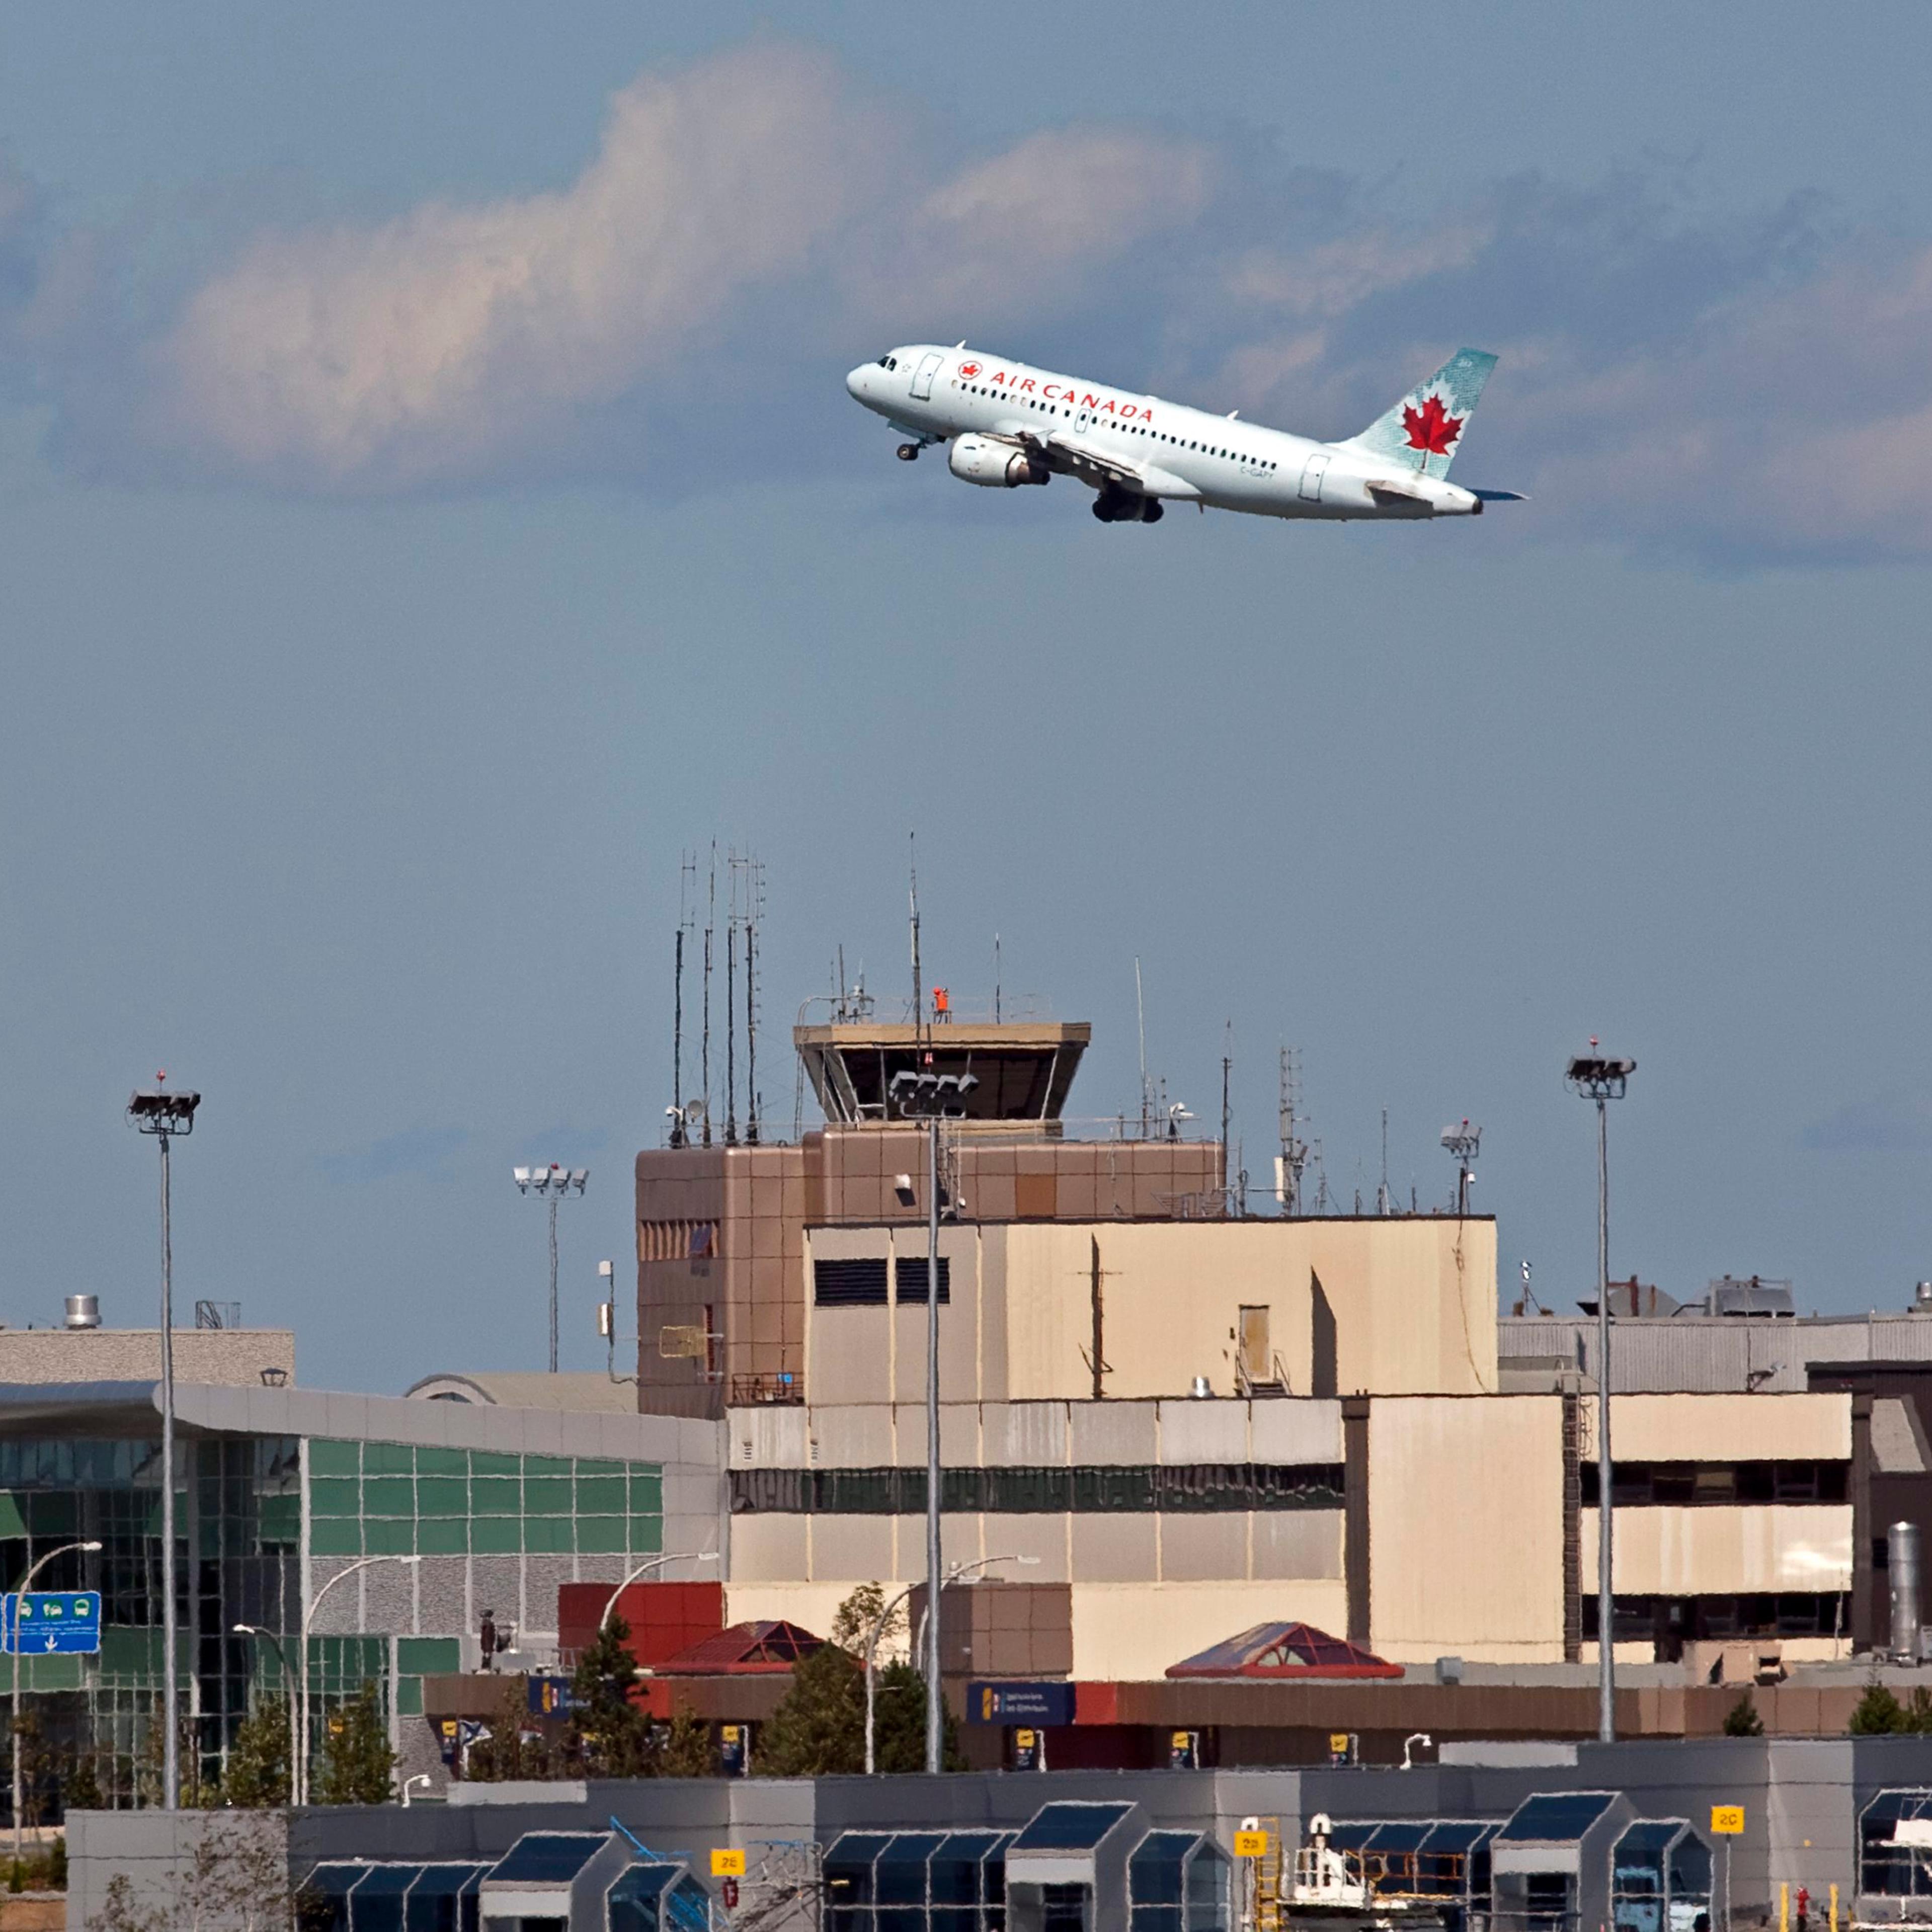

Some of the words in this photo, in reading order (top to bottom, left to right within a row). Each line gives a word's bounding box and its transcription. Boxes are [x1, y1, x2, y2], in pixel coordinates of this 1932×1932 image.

[990, 372, 1036, 393] AIR
[1042, 384, 1153, 423] CANADA
[1720, 1813, 1737, 1826] 2C
